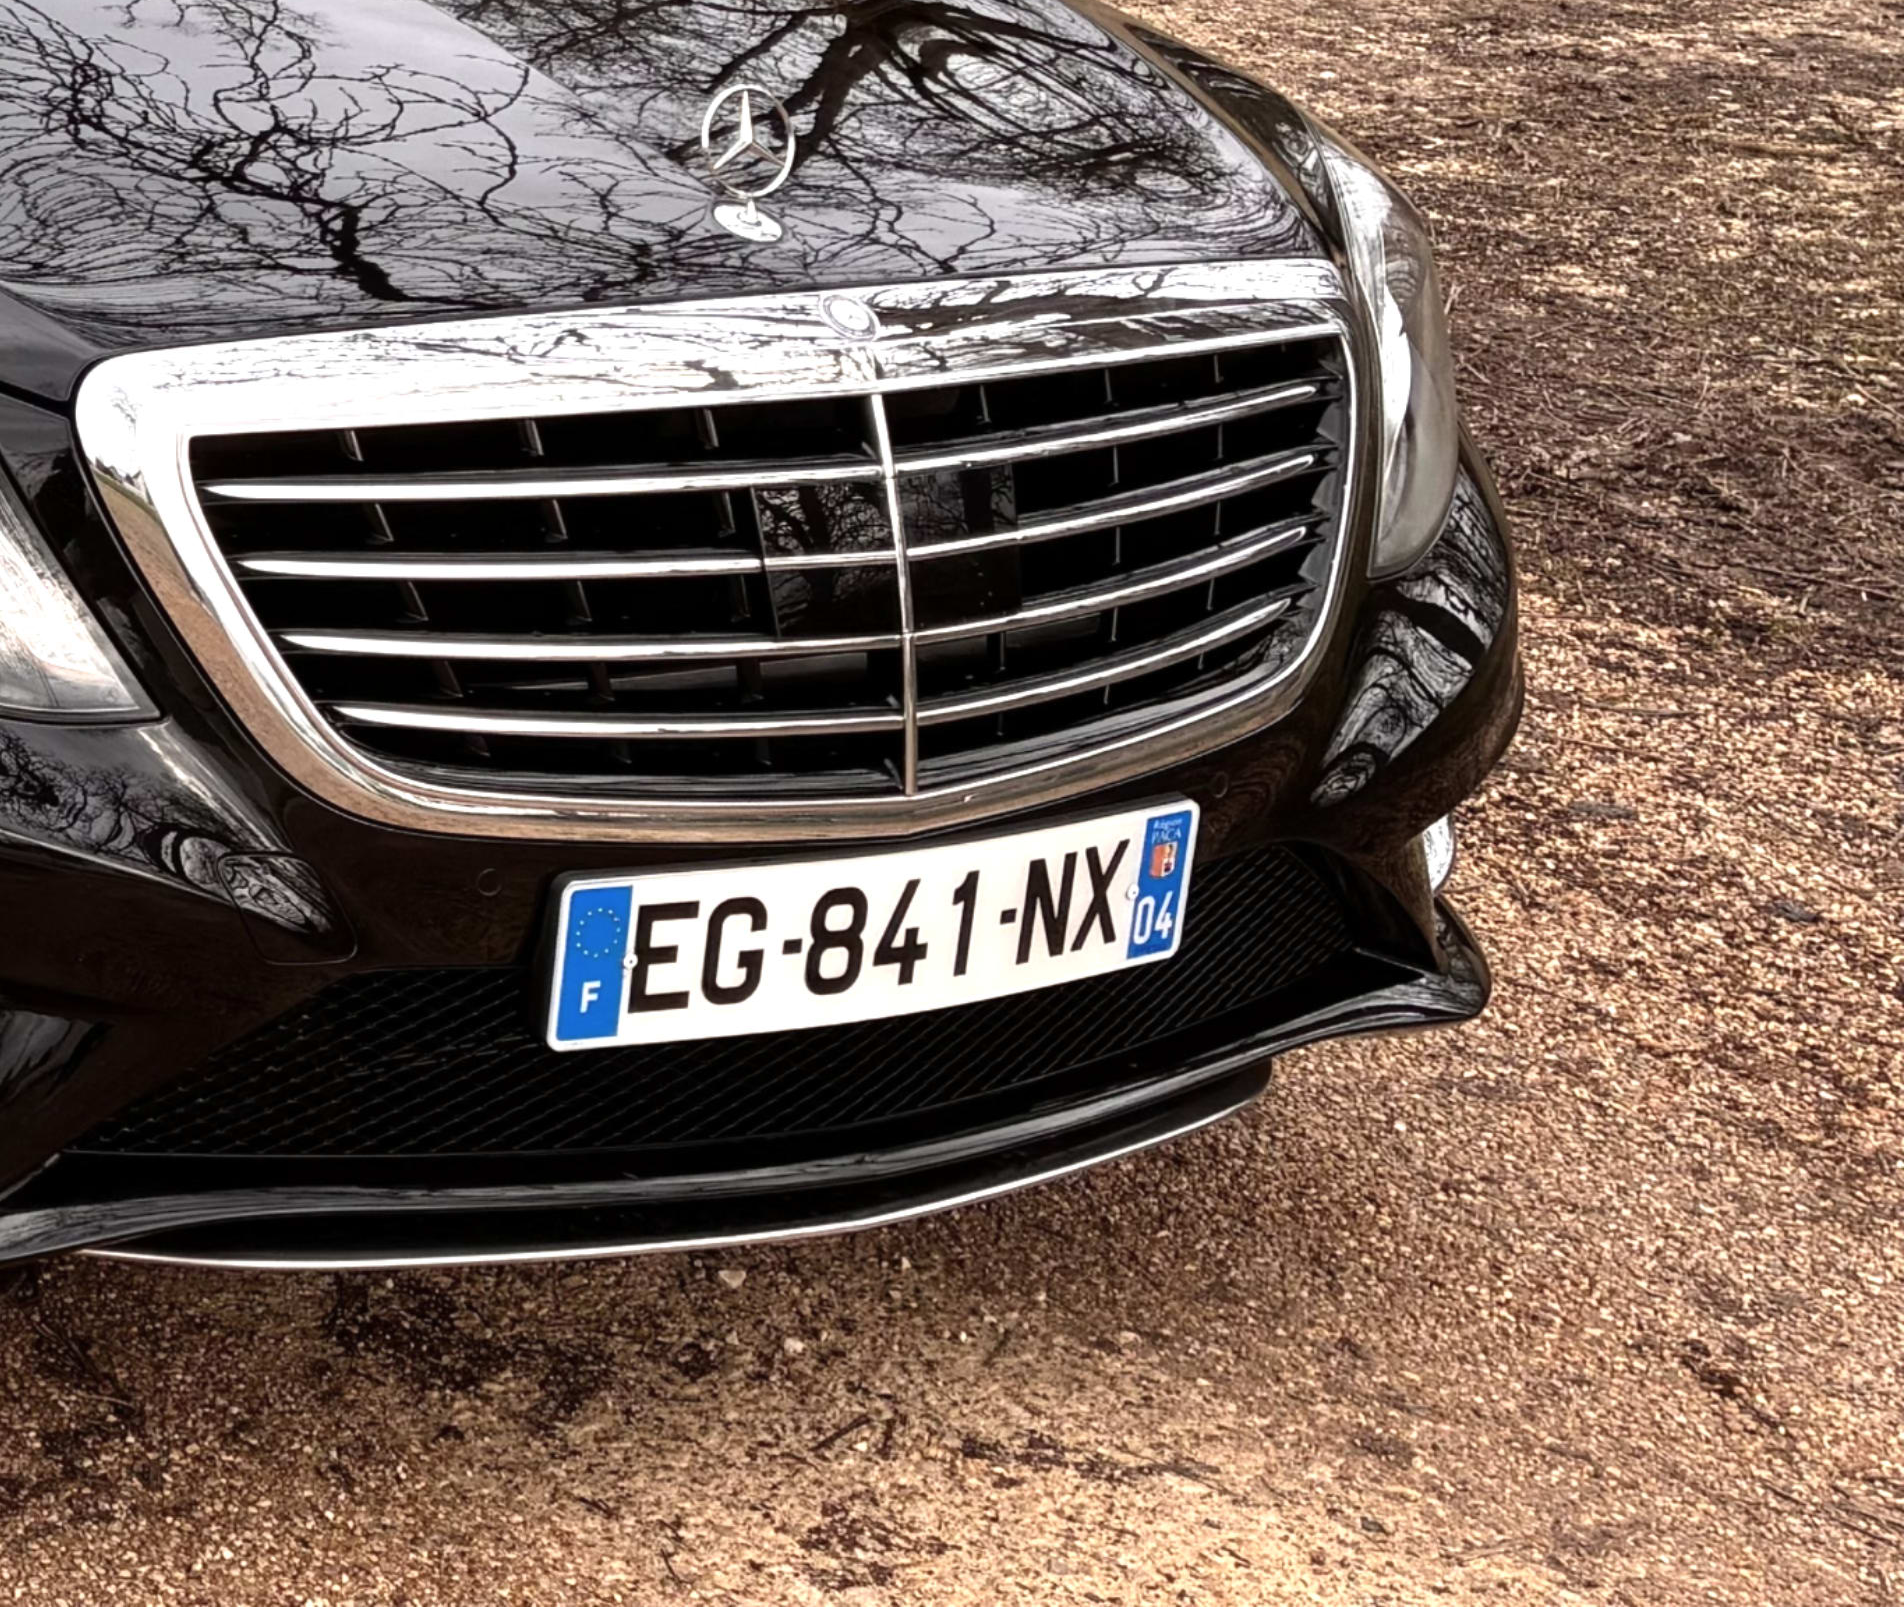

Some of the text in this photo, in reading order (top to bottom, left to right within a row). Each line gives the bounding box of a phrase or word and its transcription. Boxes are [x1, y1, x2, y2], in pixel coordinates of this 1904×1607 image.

[1151, 827, 1182, 844] PACA
[628, 839, 1130, 1014] EG-841-NX
[1133, 890, 1174, 945] 04
[579, 980, 601, 1013] F
